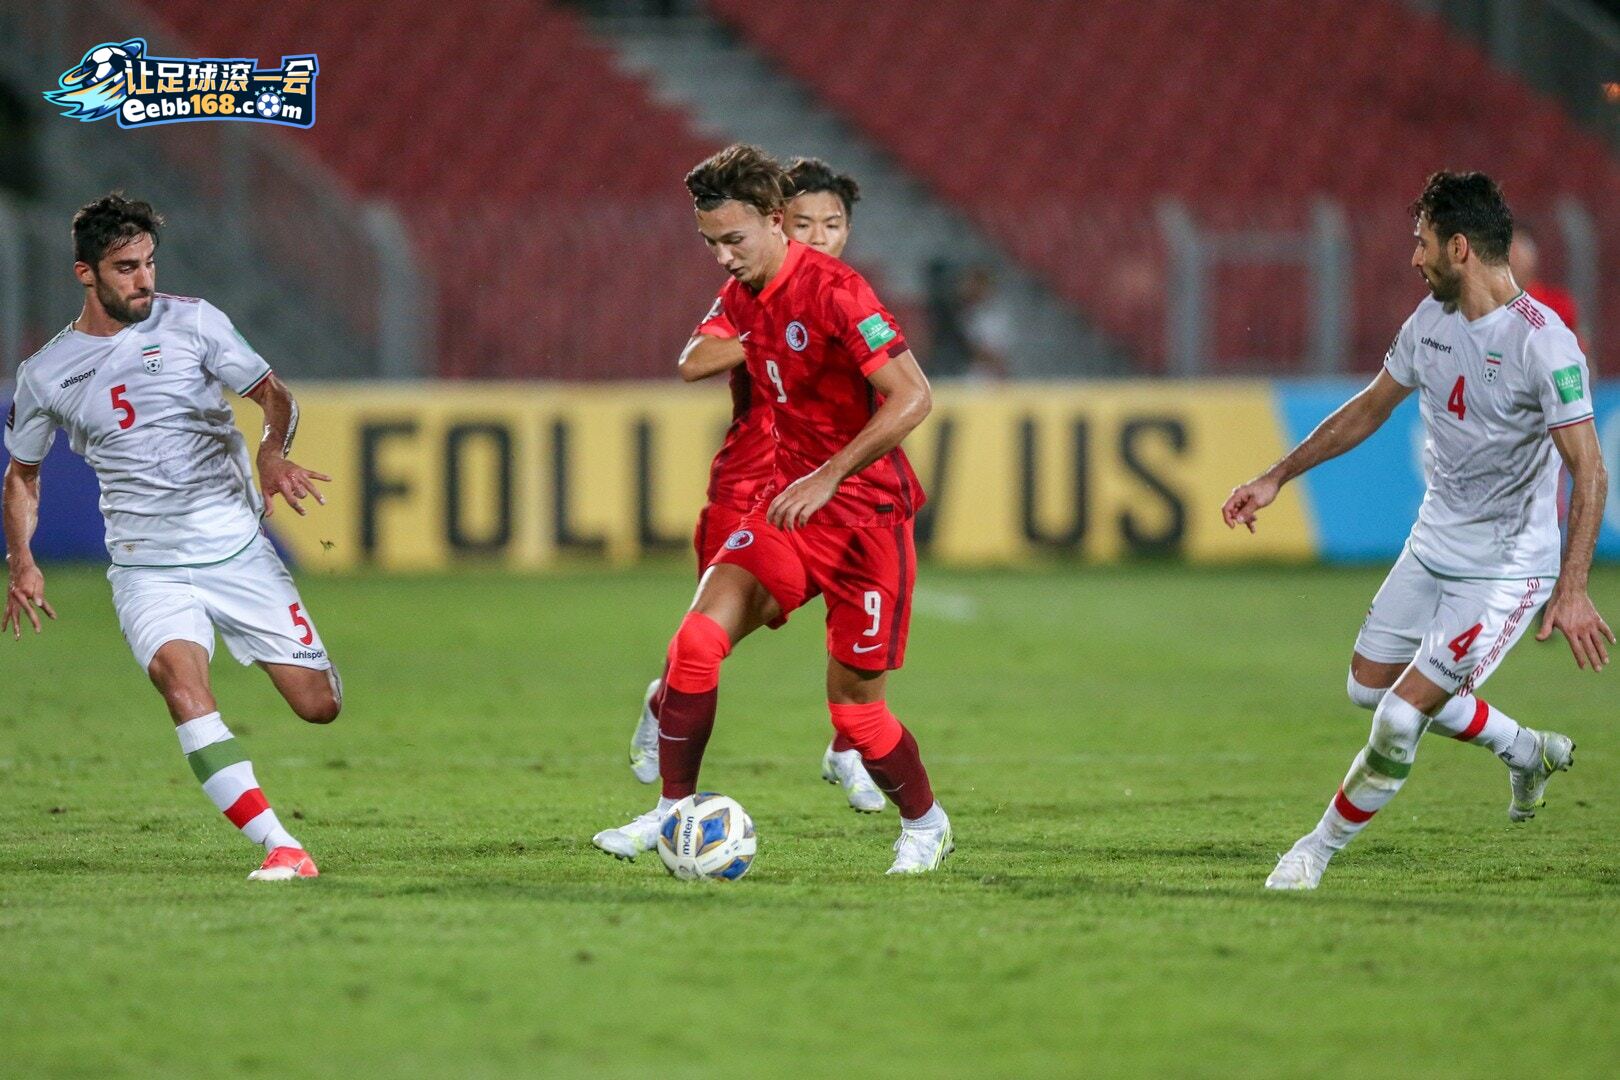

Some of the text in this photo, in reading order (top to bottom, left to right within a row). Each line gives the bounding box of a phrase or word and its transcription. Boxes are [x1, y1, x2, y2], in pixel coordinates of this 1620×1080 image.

[60, 368, 96, 389] uhlsport
[766, 359, 787, 403] 9
[1447, 375, 1467, 421] 4
[110, 384, 136, 430] 5
[359, 413, 1188, 555] FOLL US
[288, 602, 313, 646] 5
[863, 591, 881, 637] 9
[1447, 622, 1484, 663] 4
[1429, 656, 1463, 683] uhlsport
[682, 816, 694, 856] molten
